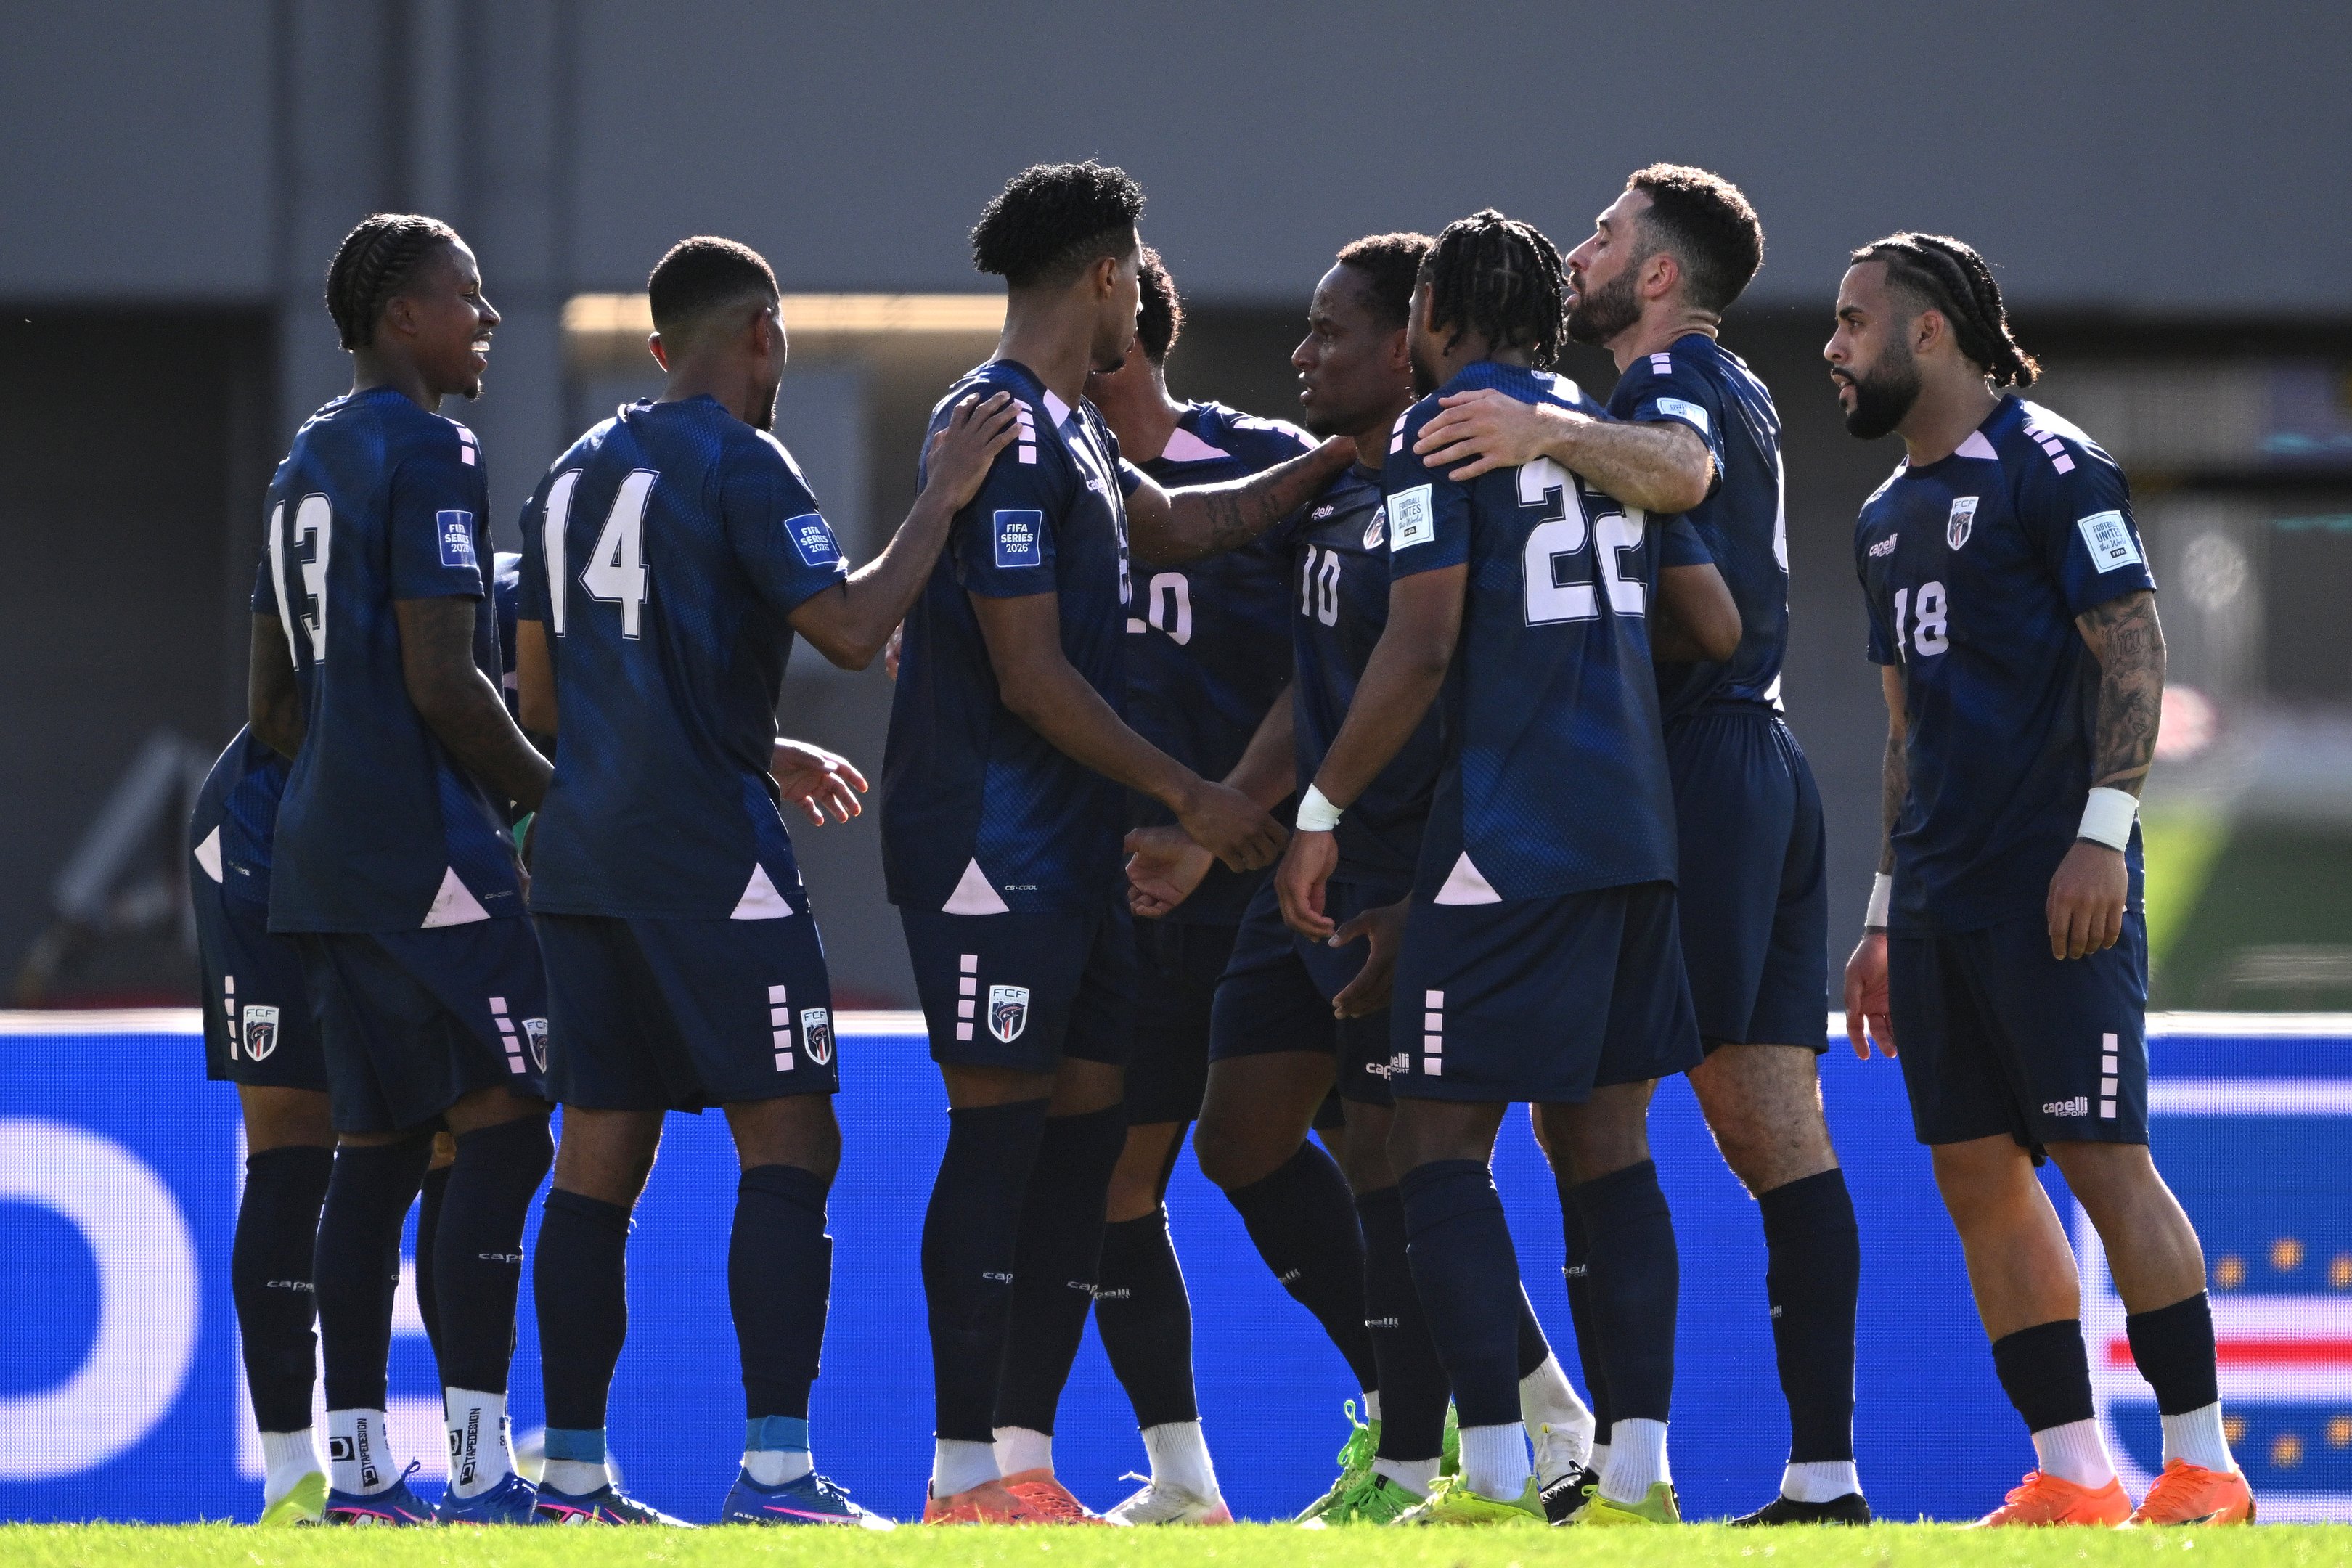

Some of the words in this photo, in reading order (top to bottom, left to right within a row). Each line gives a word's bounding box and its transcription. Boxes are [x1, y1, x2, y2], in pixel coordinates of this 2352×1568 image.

[1954, 499, 1976, 510] FCF
[1399, 503, 1421, 520] UNITES
[801, 526, 821, 536] FIFA
[1006, 523, 1029, 533] FIFA
[800, 534, 829, 546] SERIES
[1000, 533, 1034, 543] SERIES
[1516, 456, 1649, 628] 22
[2095, 528, 2123, 543] UNITES
[809, 543, 830, 553] 2026
[1869, 533, 1898, 557] capelli
[2099, 542, 2111, 552] the
[543, 468, 661, 641] 14
[2112, 548, 2126, 558] FIFA
[268, 492, 334, 673] 13
[1302, 544, 1341, 628] 10
[1894, 581, 1951, 664] 18
[993, 988, 1026, 998] FCF
[246, 1008, 276, 1018] FCF
[804, 1010, 825, 1021] FCF
[2043, 1096, 2088, 1116] capelli
[465, 1408, 481, 1463] TAPEDESIGN
[357, 1418, 372, 1467] TAPEDESIGN
